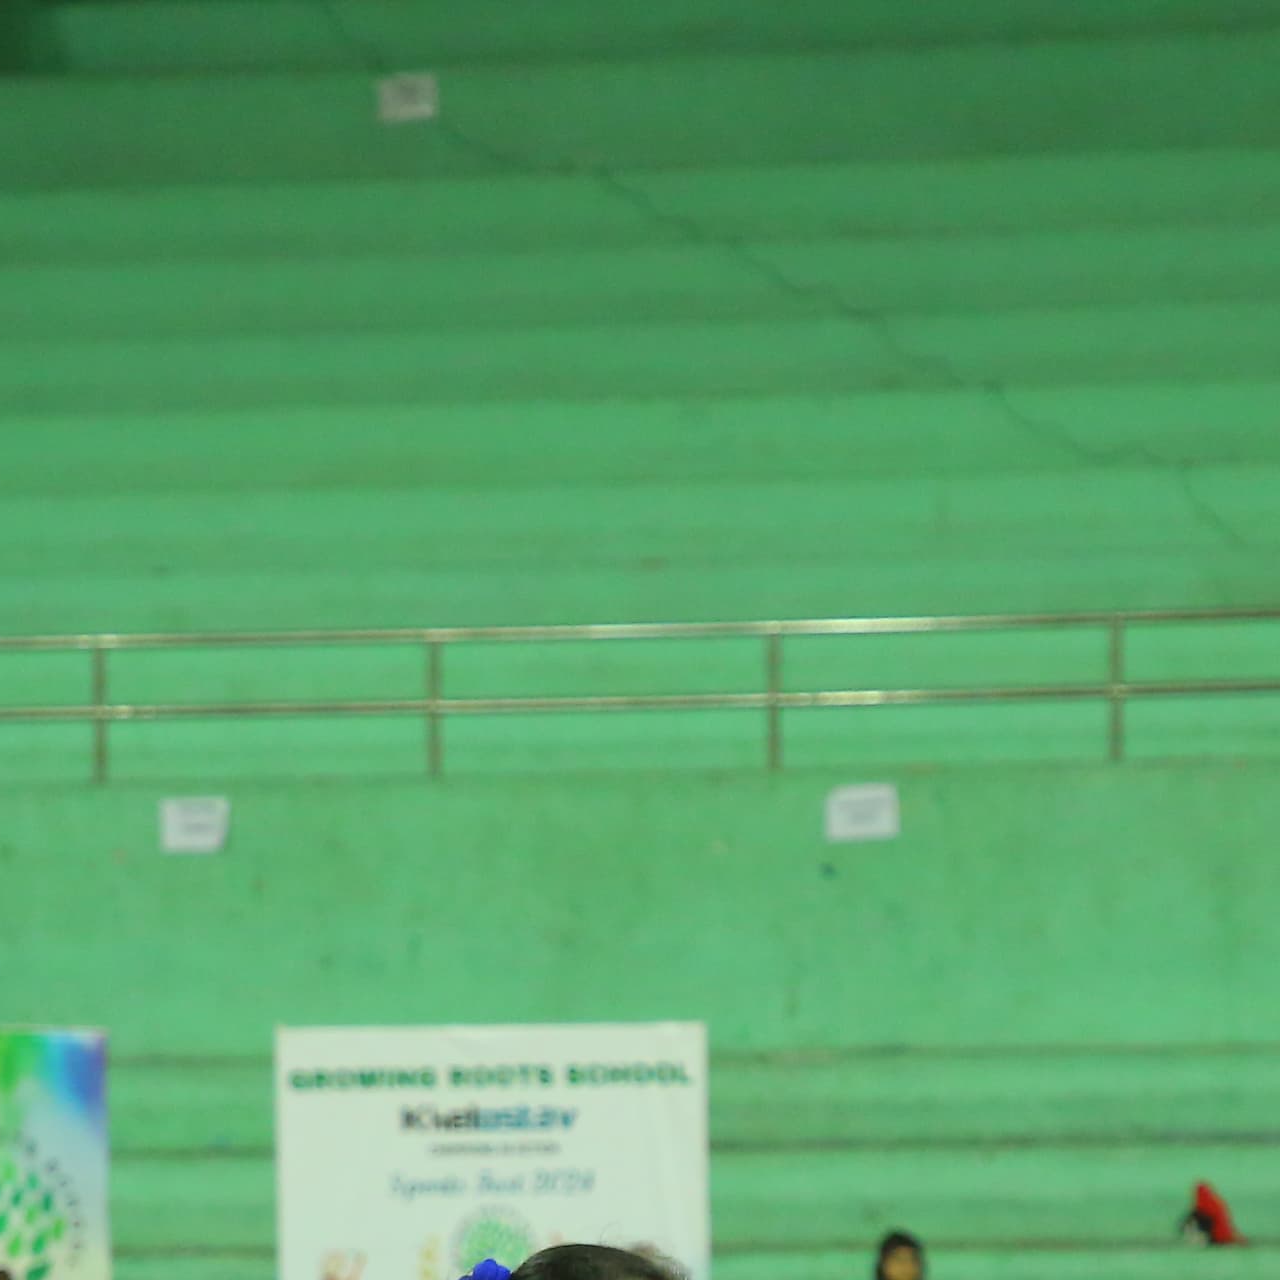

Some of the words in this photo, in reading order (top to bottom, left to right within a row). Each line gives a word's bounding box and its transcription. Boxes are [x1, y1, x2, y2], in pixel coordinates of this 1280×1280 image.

[290, 1066, 435, 1090] GROWING
[450, 1064, 552, 1088] ROOTS
[566, 1062, 690, 1086] SCHOOL
